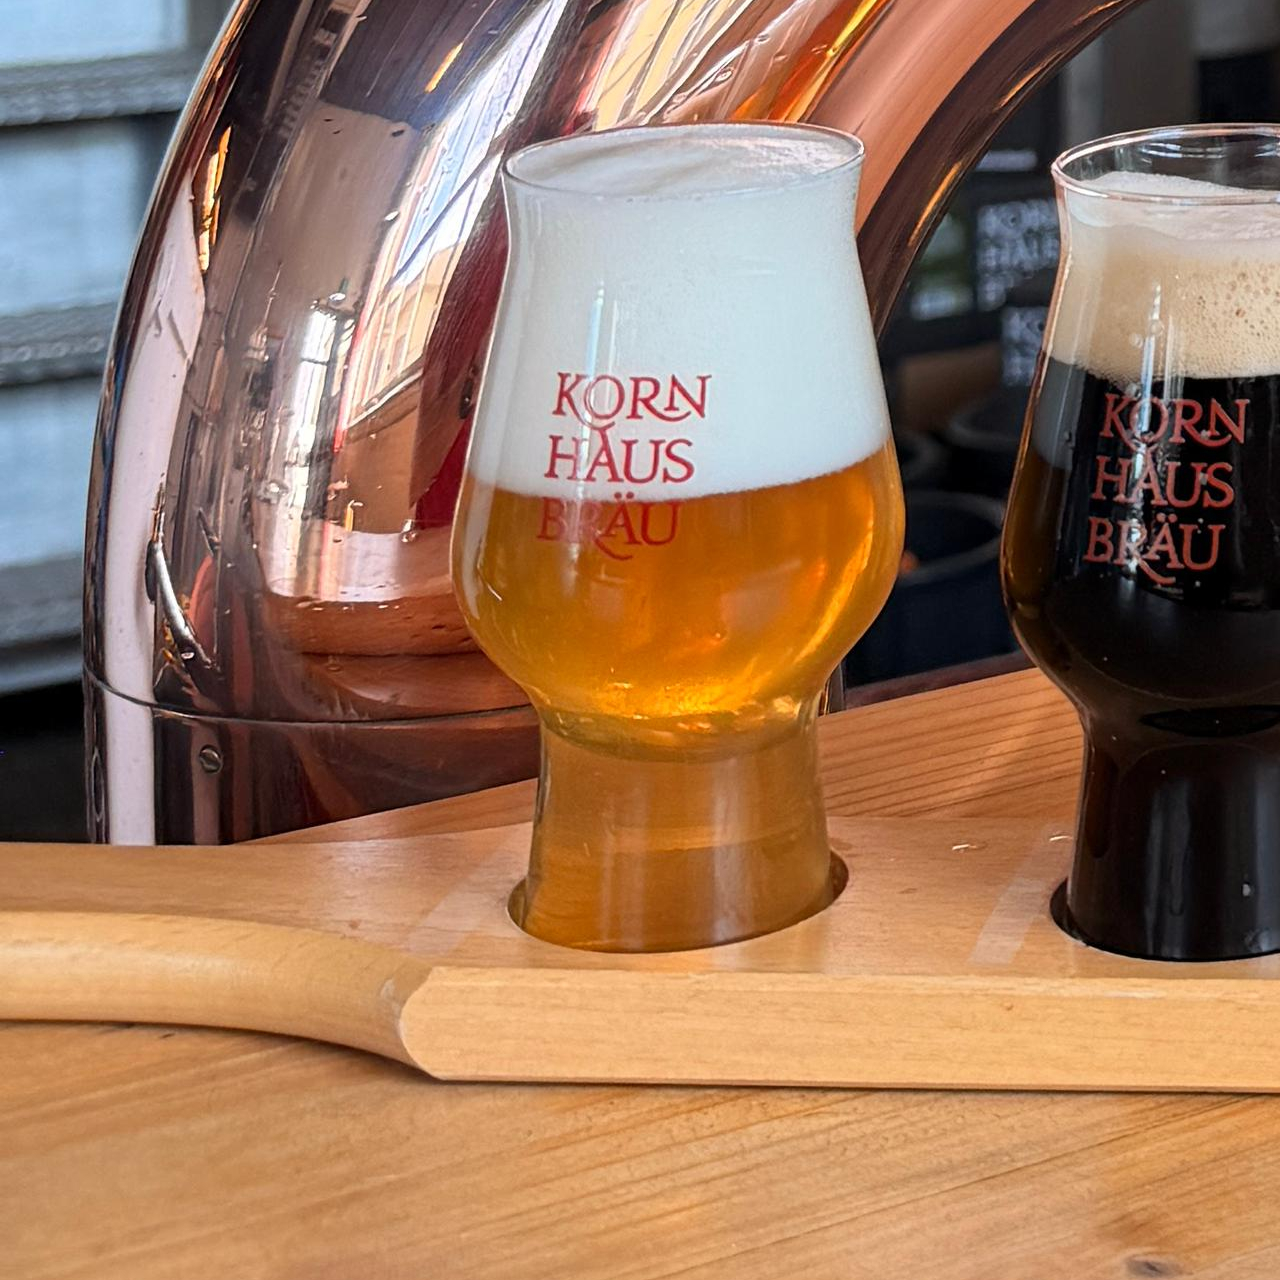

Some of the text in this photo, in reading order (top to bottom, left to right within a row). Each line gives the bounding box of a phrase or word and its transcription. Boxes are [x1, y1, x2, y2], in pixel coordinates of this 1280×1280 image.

[552, 372, 712, 429] KORN
[1102, 393, 1250, 450] KORN
[543, 424, 695, 484] HAUS
[1091, 449, 1235, 508] HAUS
[536, 491, 681, 560] BRÄU
[1083, 513, 1226, 584] BRÄU
